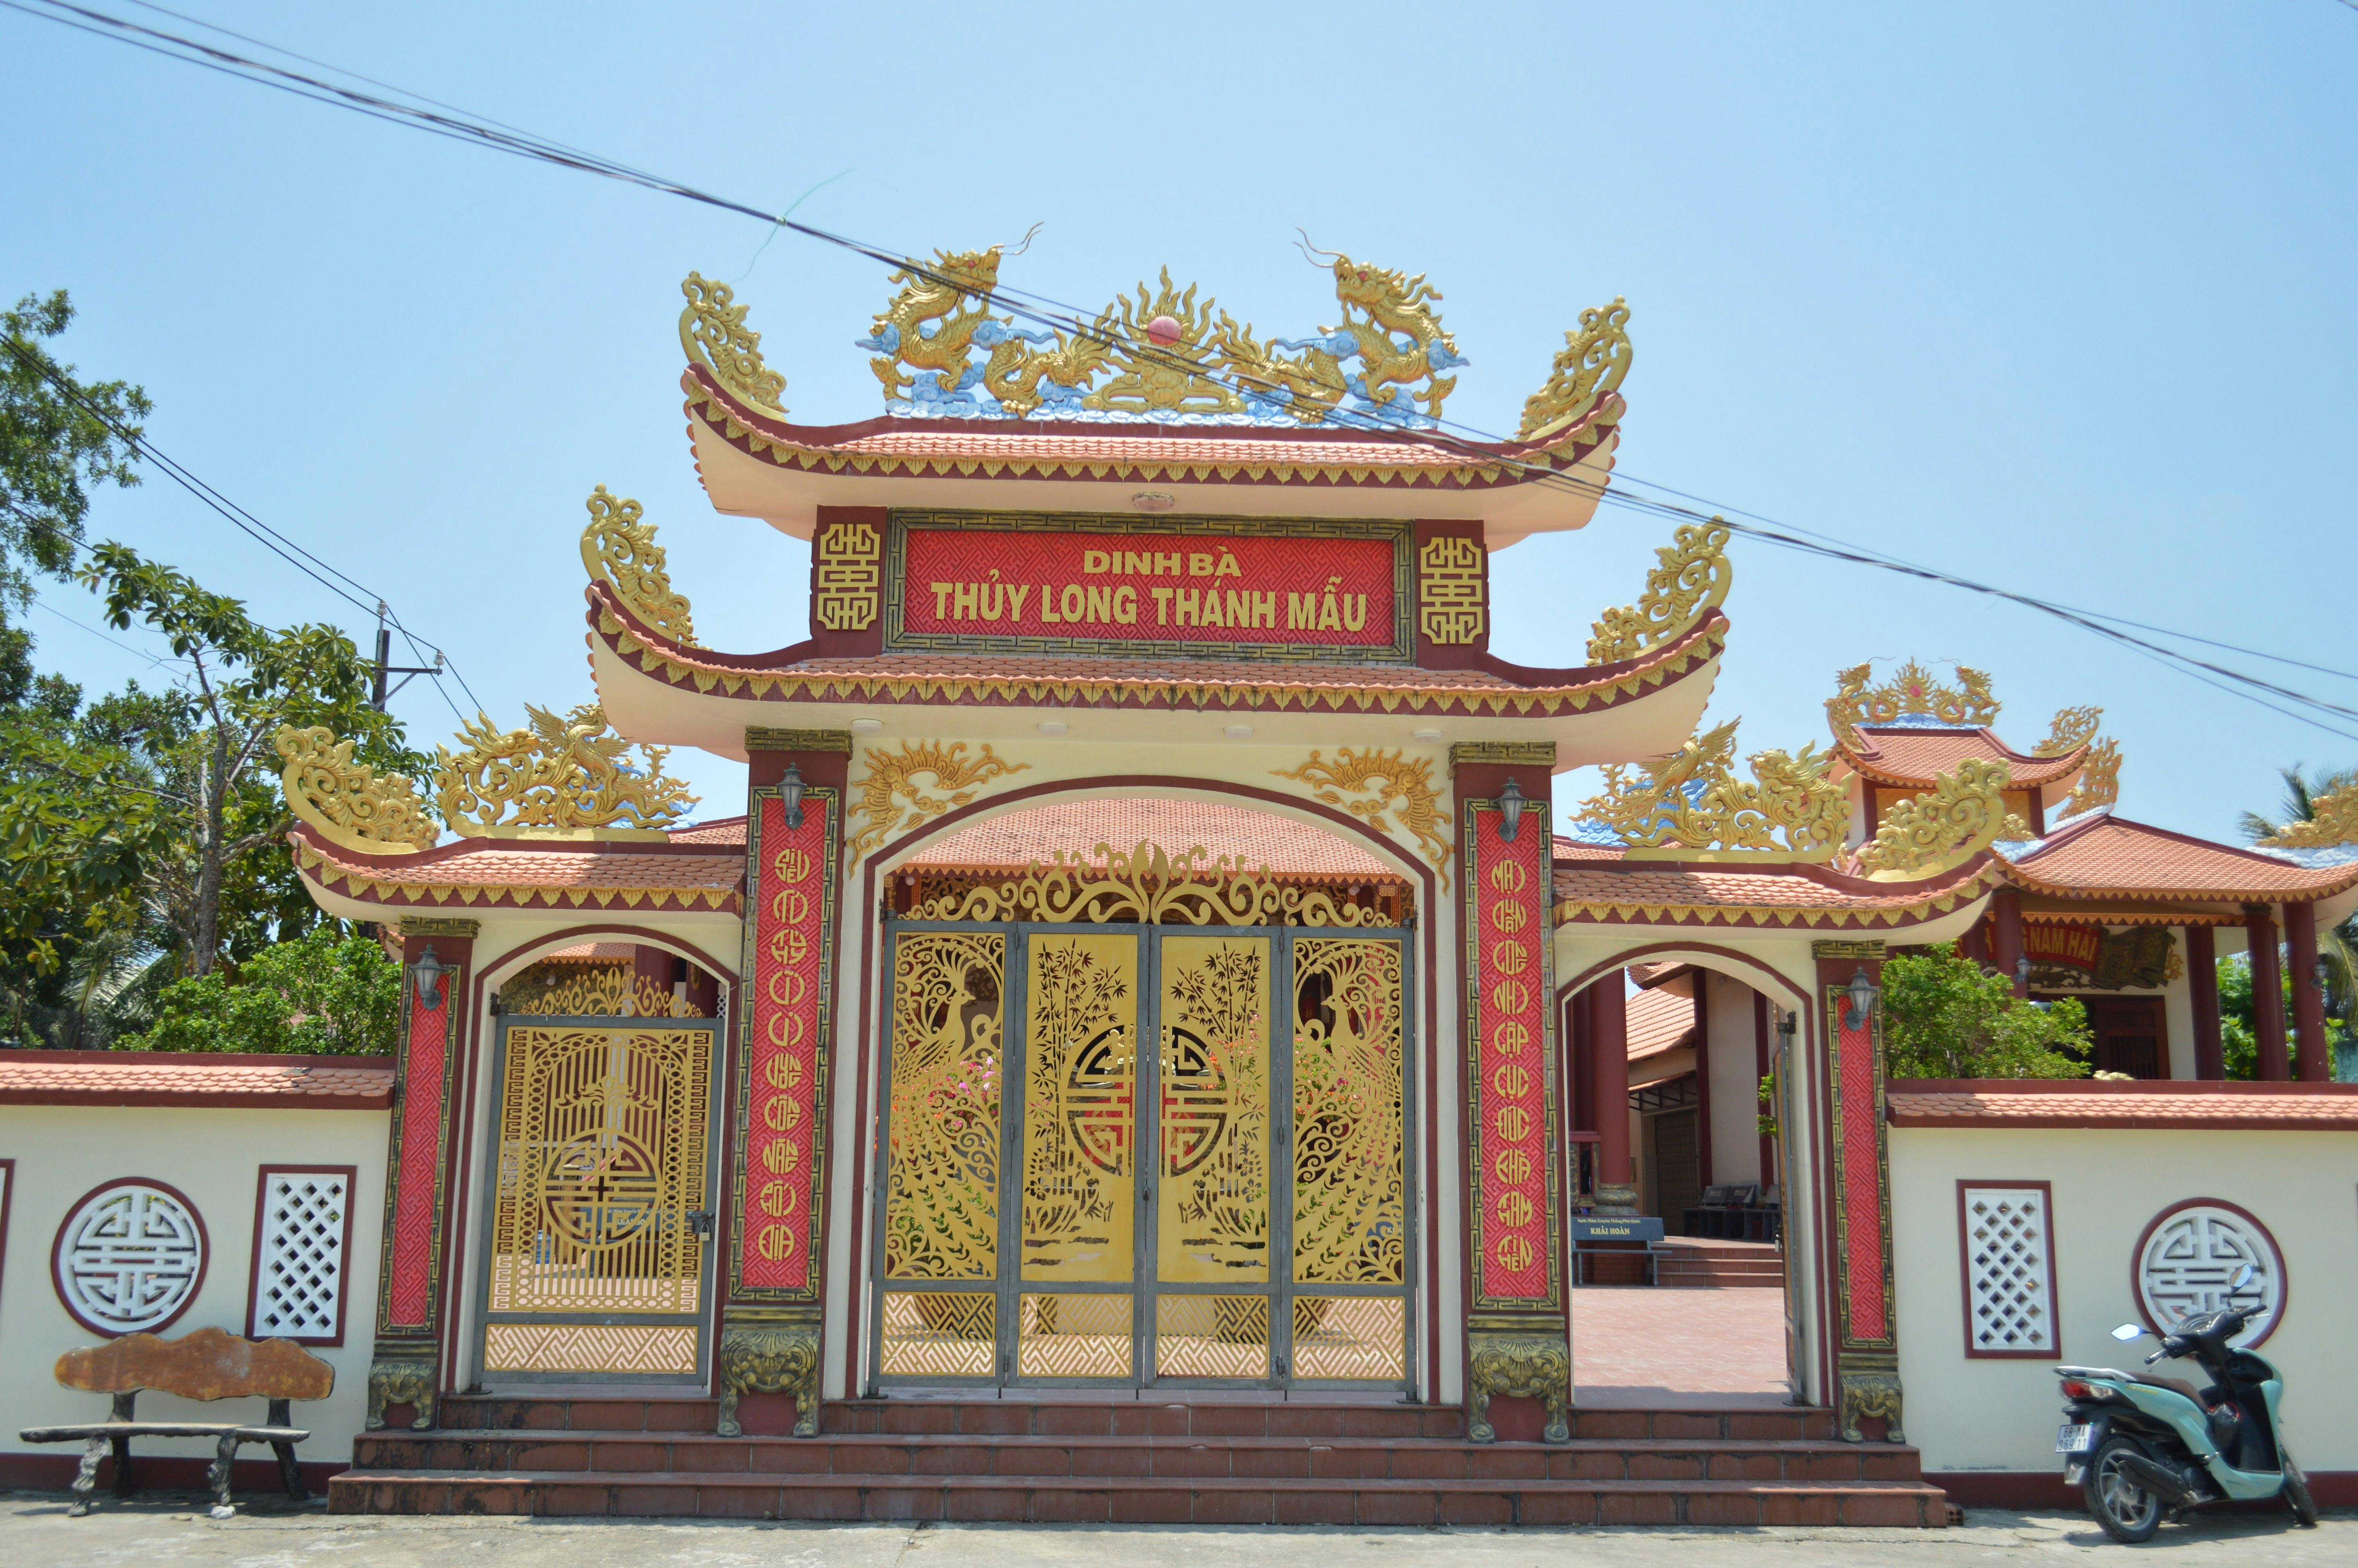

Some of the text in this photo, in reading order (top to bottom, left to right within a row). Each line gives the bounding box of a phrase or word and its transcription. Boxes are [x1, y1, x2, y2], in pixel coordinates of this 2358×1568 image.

[1084, 546, 1241, 577] DINH BÀ
[931, 569, 1367, 631] THỦY LONG THÁNH MẪU
[2030, 927, 2064, 954] NAM
[2067, 927, 2099, 962] HẢI
[764, 1095, 800, 1131] CÔNG
[1498, 1191, 1533, 1227] THAM
[758, 1224, 795, 1260] ĐỊA
[1590, 1225, 1630, 1235] KHẢI HOÀN
[2058, 1438, 2087, 1450] 069.11
[2063, 1426, 2085, 1437] 68-MA
